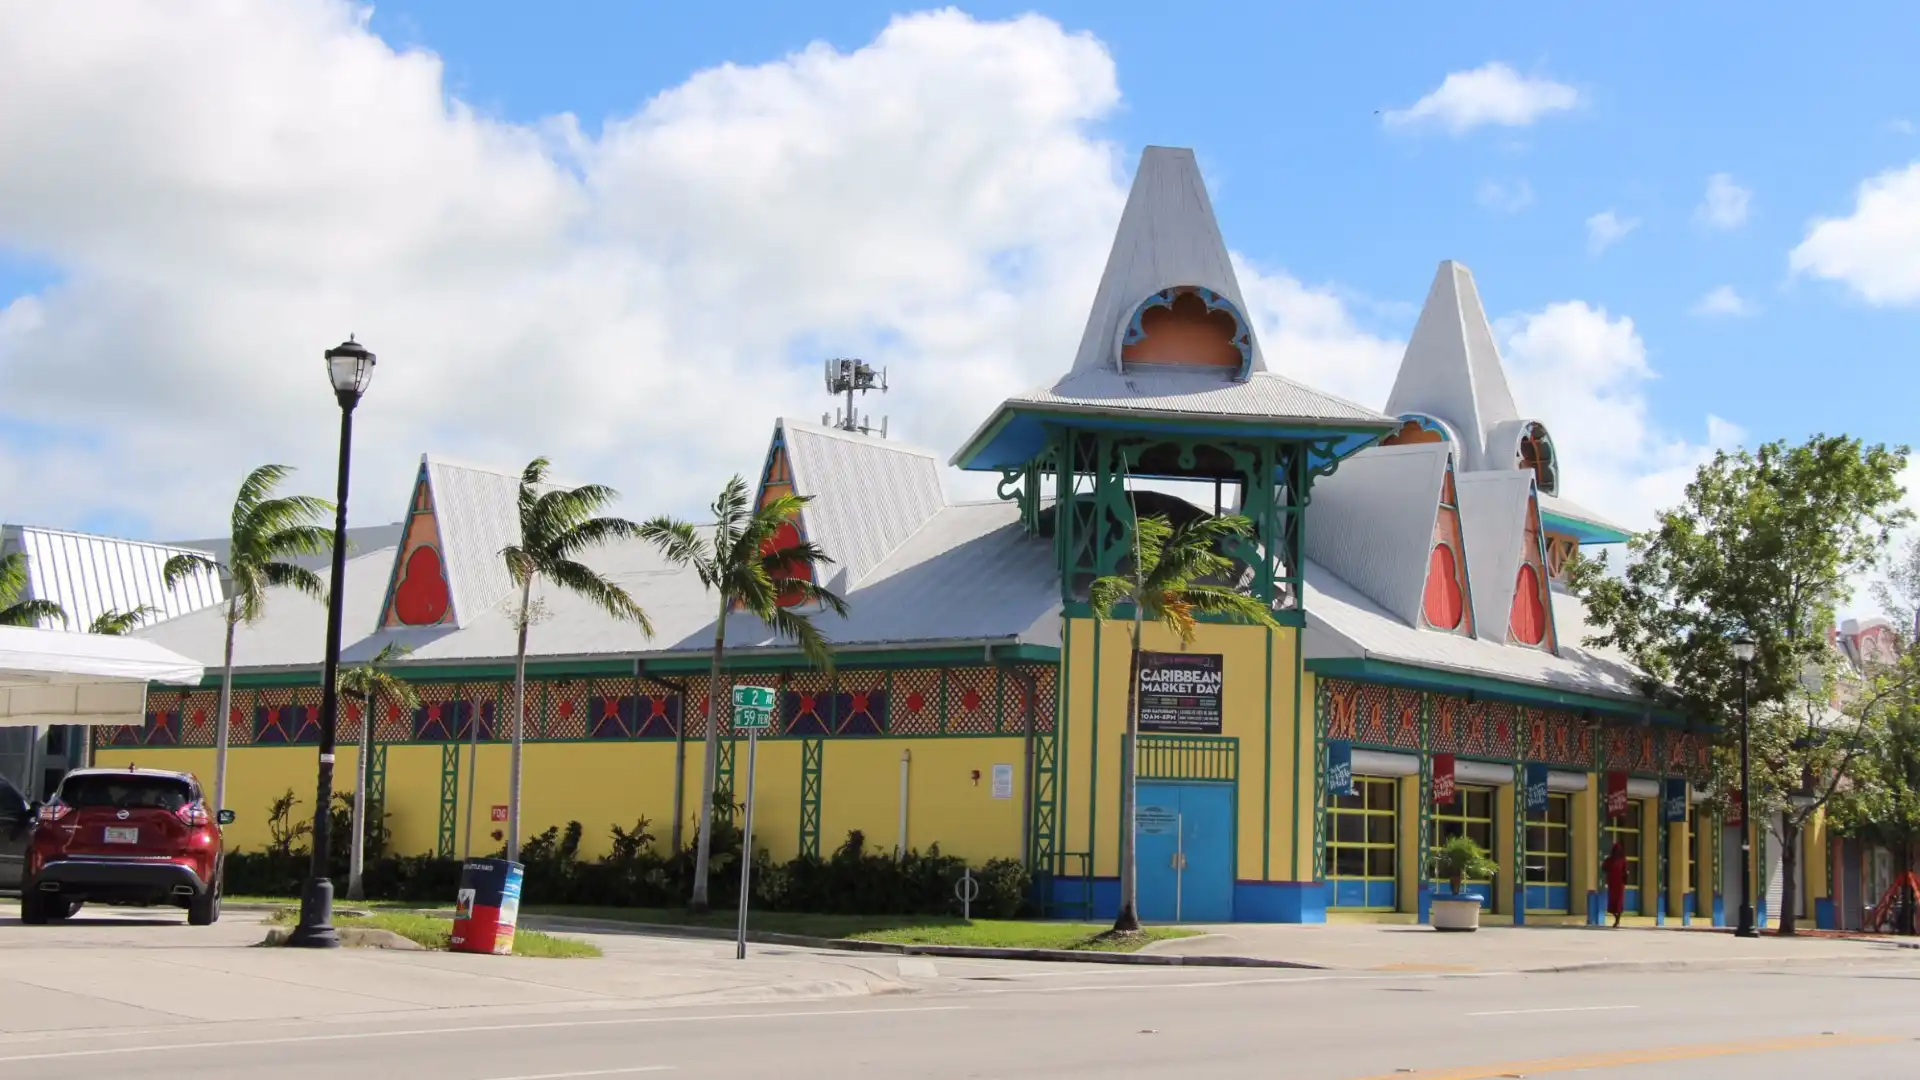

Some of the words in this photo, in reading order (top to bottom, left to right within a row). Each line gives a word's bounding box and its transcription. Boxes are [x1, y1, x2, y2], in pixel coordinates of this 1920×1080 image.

[1140, 668, 1222, 683] CARIBBEAN
[1141, 683, 1193, 693] MARKET
[1196, 684, 1221, 694] DAY
[735, 691, 744, 703] NE
[751, 690, 759, 705] 2
[744, 710, 755, 725] 59
[757, 713, 769, 724] TER
